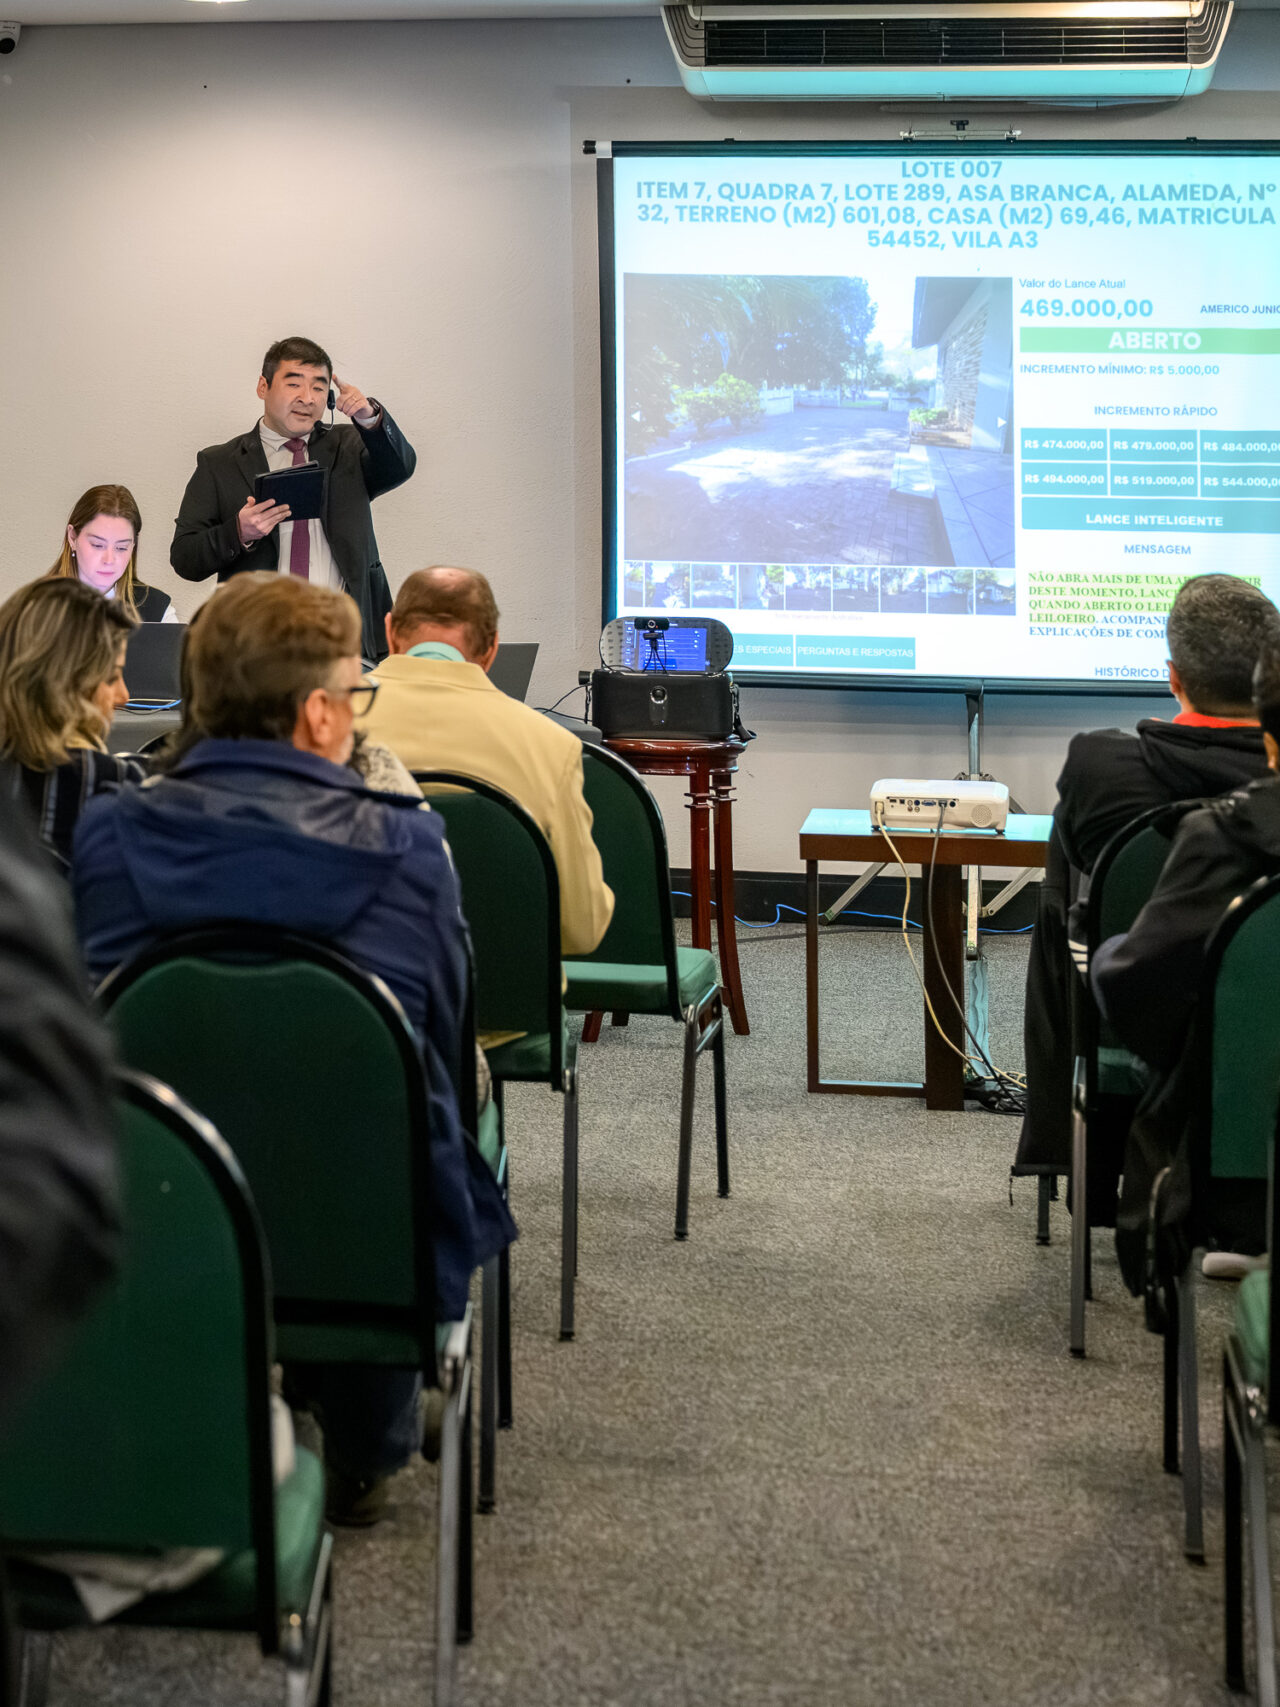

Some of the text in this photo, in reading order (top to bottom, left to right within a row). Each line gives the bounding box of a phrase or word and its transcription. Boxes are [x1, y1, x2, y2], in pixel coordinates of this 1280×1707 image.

[901, 160, 1003, 179] LOTE 007
[636, 181, 689, 199] ITEM
[694, 182, 711, 202] 7,
[718, 182, 815, 201] QUADRA
[821, 183, 838, 203] 7,
[845, 183, 898, 201] LOTE
[904, 183, 950, 203] 289,
[958, 183, 1003, 201] ASA
[1010, 183, 1114, 203] BRANCA,
[1122, 183, 1242, 204] ALAMEDA,
[637, 202, 1276, 229] 32, TERRENO (M2) 601,08, CASA (M2) 69,46, MATRICULA
[867, 229, 1038, 250] 54452, VILA A3
[1019, 278, 1126, 289] Valor do Lance Atual
[1020, 298, 1153, 320] 469.000,00
[1200, 305, 1249, 314] AMERICO
[1108, 332, 1202, 350] ABERTO
[1020, 362, 1220, 377] INCREMENTO MÍNIMO: R$ 5.000,00
[1094, 405, 1170, 416] INCREMENTO
[1024, 440, 1104, 452] R$ 474.000,00
[1113, 441, 1194, 453] R$ 479.000,00
[1203, 442, 1219, 452] R$
[1024, 474, 1104, 486] R$ 494.000,00
[1114, 475, 1194, 487] R$ 519.000,00
[1204, 477, 1219, 487] R$
[1086, 514, 1224, 526] LANCE INTELIGENTE
[1124, 544, 1192, 555] MENSAGEM
[1028, 571, 1054, 583] NÃO
[1056, 573, 1089, 584] ABRA
[1091, 574, 1123, 584] MAIS
[1125, 574, 1142, 584] DE
[1145, 575, 1172, 585] UMA
[1028, 586, 1067, 596] DESTE
[1070, 587, 1138, 598] MOMENTO,
[1028, 600, 1081, 611] QUANDO
[1083, 601, 1132, 611] ABERTO
[1135, 602, 1144, 611] O
[1028, 625, 1114, 638] EXPLICAÇÕES
[1117, 628, 1133, 638] DE
[746, 645, 792, 655] ESPECIAIS
[797, 646, 914, 658] PERGUNTAS E RESPOSTAS
[1094, 665, 1159, 678] HISTÓRICO
